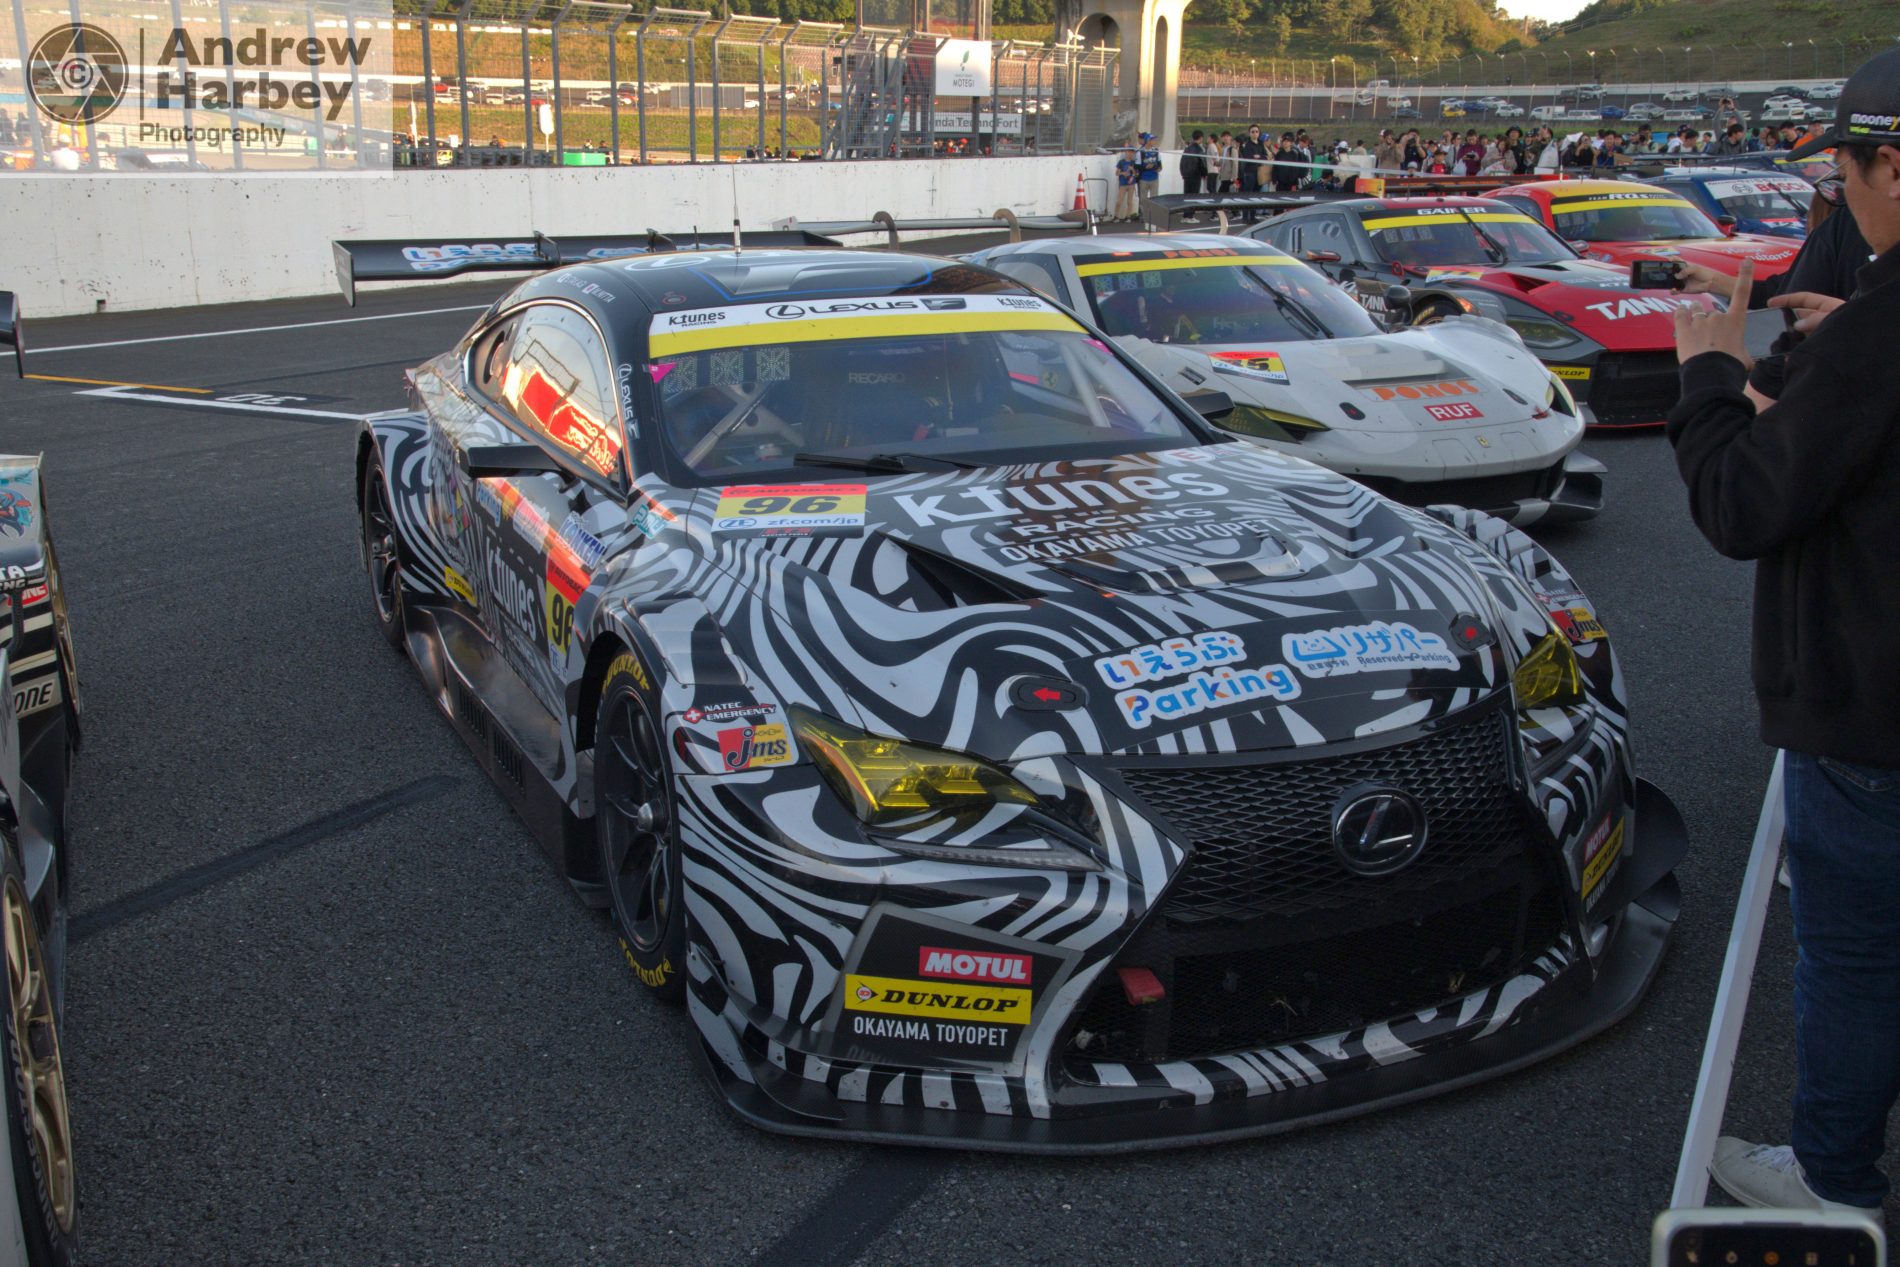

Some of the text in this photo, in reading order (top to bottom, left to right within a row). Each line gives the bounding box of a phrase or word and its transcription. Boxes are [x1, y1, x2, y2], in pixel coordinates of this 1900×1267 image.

[953, 78, 975, 88] MOTEGI
[810, 300, 918, 315] LEXUS
[682, 320, 717, 328] RACING
[619, 380, 635, 419] LEXUS
[1429, 404, 1474, 419] RUF
[738, 496, 841, 515] 96
[767, 518, 859, 526] zf.com/jp
[1010, 506, 1214, 537] RACING
[1001, 517, 1283, 563] OKAYAMA TOYOPET
[1103, 636, 1239, 684] いえらぶ
[1357, 652, 1452, 665] Reserved Parking
[1125, 669, 1294, 722] Parking
[704, 701, 742, 712] NATEC
[706, 707, 776, 721] EMERGENCY
[924, 952, 1027, 981] MOTUL
[880, 989, 1019, 1013] DUNLOP
[853, 1017, 1009, 1047] OKAYAMA TOYOPET
